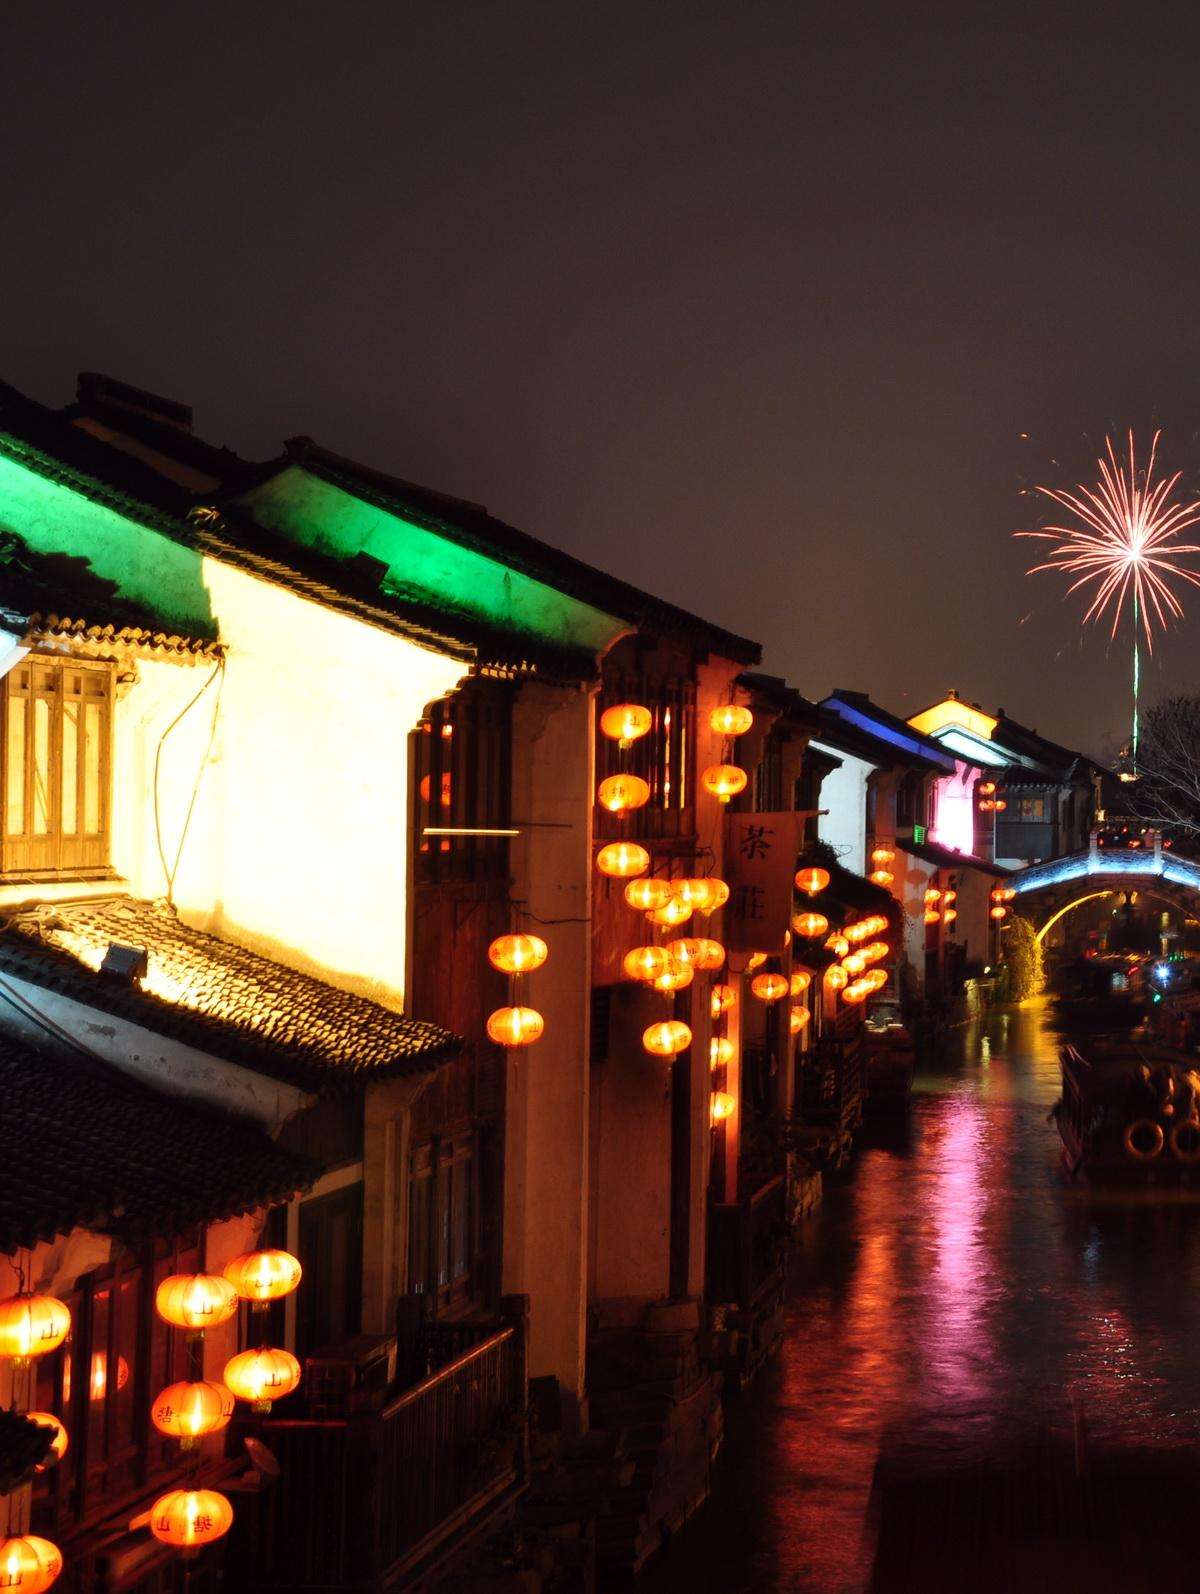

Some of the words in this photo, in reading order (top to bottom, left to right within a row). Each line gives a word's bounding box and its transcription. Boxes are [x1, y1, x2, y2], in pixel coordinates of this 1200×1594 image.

[195, 1301, 213, 1315] 山
[41, 1323, 58, 1339] 山
[265, 1373, 281, 1387] 山
[157, 1516, 170, 1532] 山
[0, 1574, 21, 1588] 山
